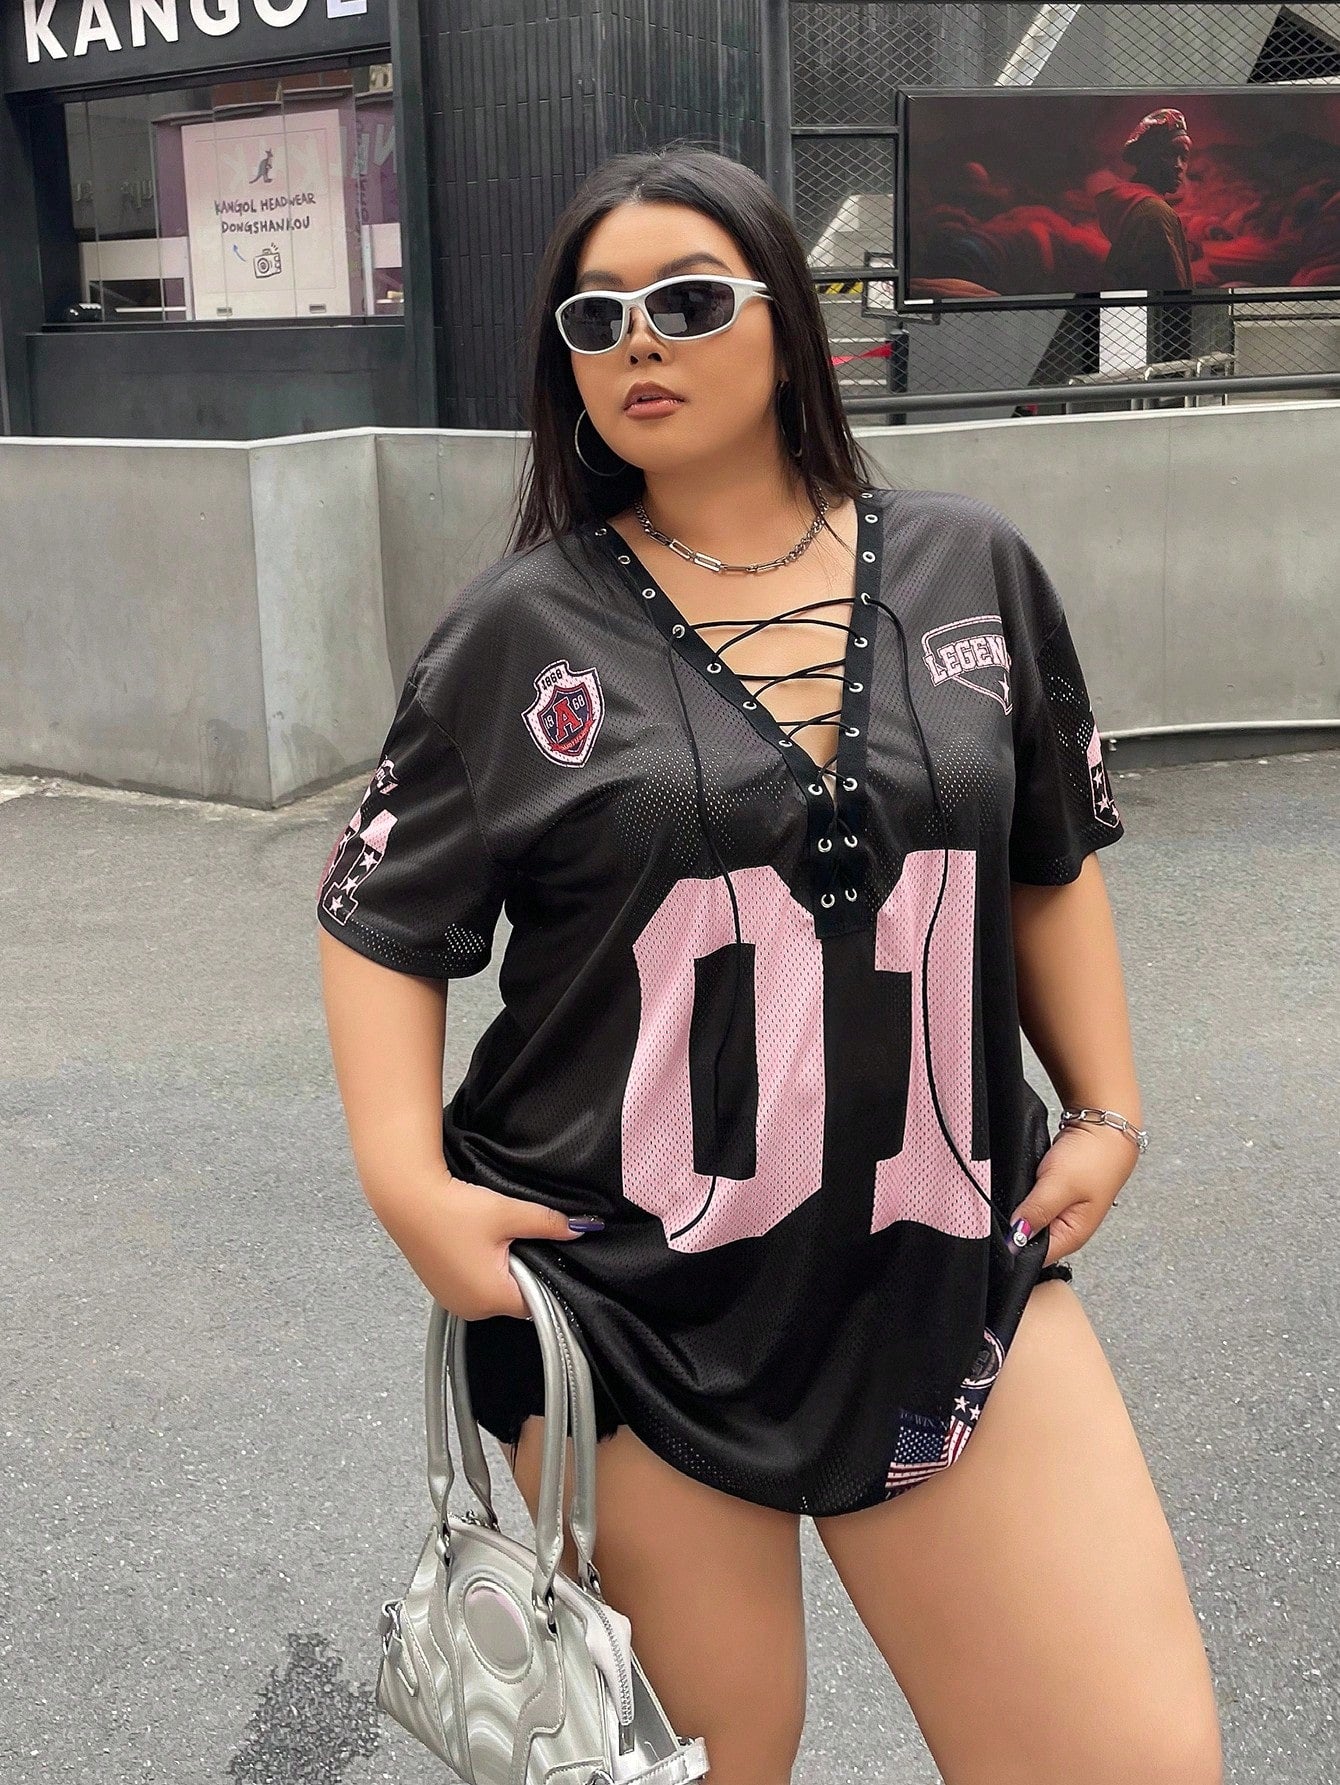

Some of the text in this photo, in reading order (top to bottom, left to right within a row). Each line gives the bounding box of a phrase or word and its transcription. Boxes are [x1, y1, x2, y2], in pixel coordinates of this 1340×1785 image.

[24, 0, 368, 63] KANG
[214, 193, 316, 217] KANGOL HEADWEAR
[221, 216, 310, 234] DONGSHANKOU
[923, 634, 1012, 687] LEGEN
[552, 696, 583, 744] A
[620, 849, 992, 1254] 01
